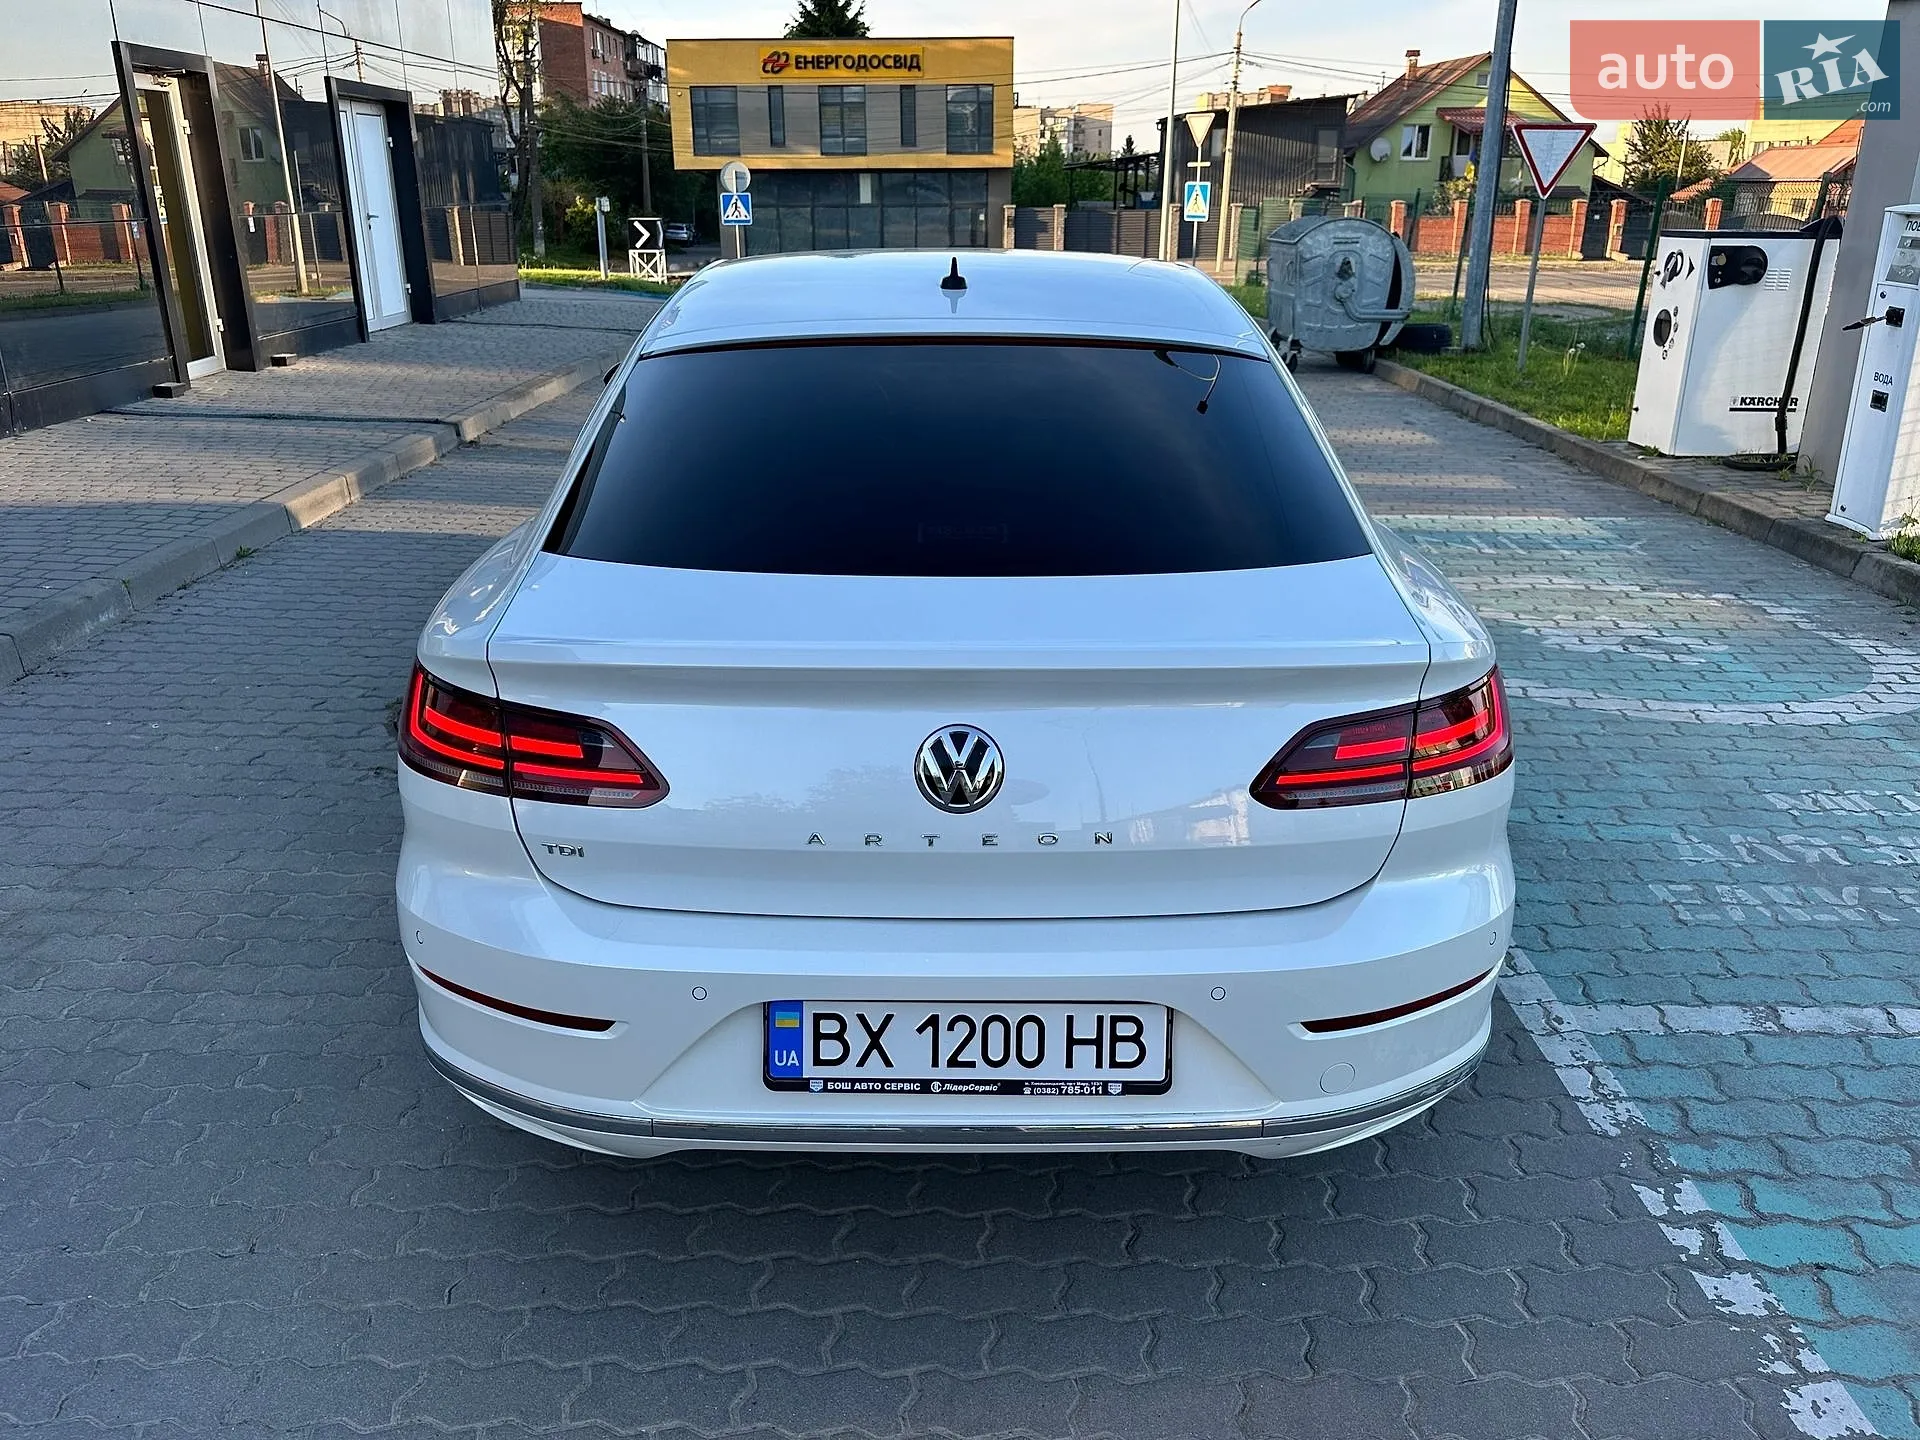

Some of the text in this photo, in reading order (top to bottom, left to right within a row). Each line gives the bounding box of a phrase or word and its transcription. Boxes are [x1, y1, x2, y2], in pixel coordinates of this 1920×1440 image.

[794, 53, 922, 72] ЕНЕРГОДОСВІД
[1873, 371, 1894, 386] ВОДА
[1740, 396, 1799, 407] KÄRCHR
[807, 832, 1113, 847] ARTEON
[541, 842, 585, 857] TDI
[915, 1014, 1046, 1069] 1200
[774, 1049, 800, 1067] UA
[827, 1082, 851, 1090] БОШ
[854, 1082, 882, 1090] АВТО
[884, 1082, 921, 1091] СЕРВІС
[1033, 1087, 1059, 1096] (0382)
